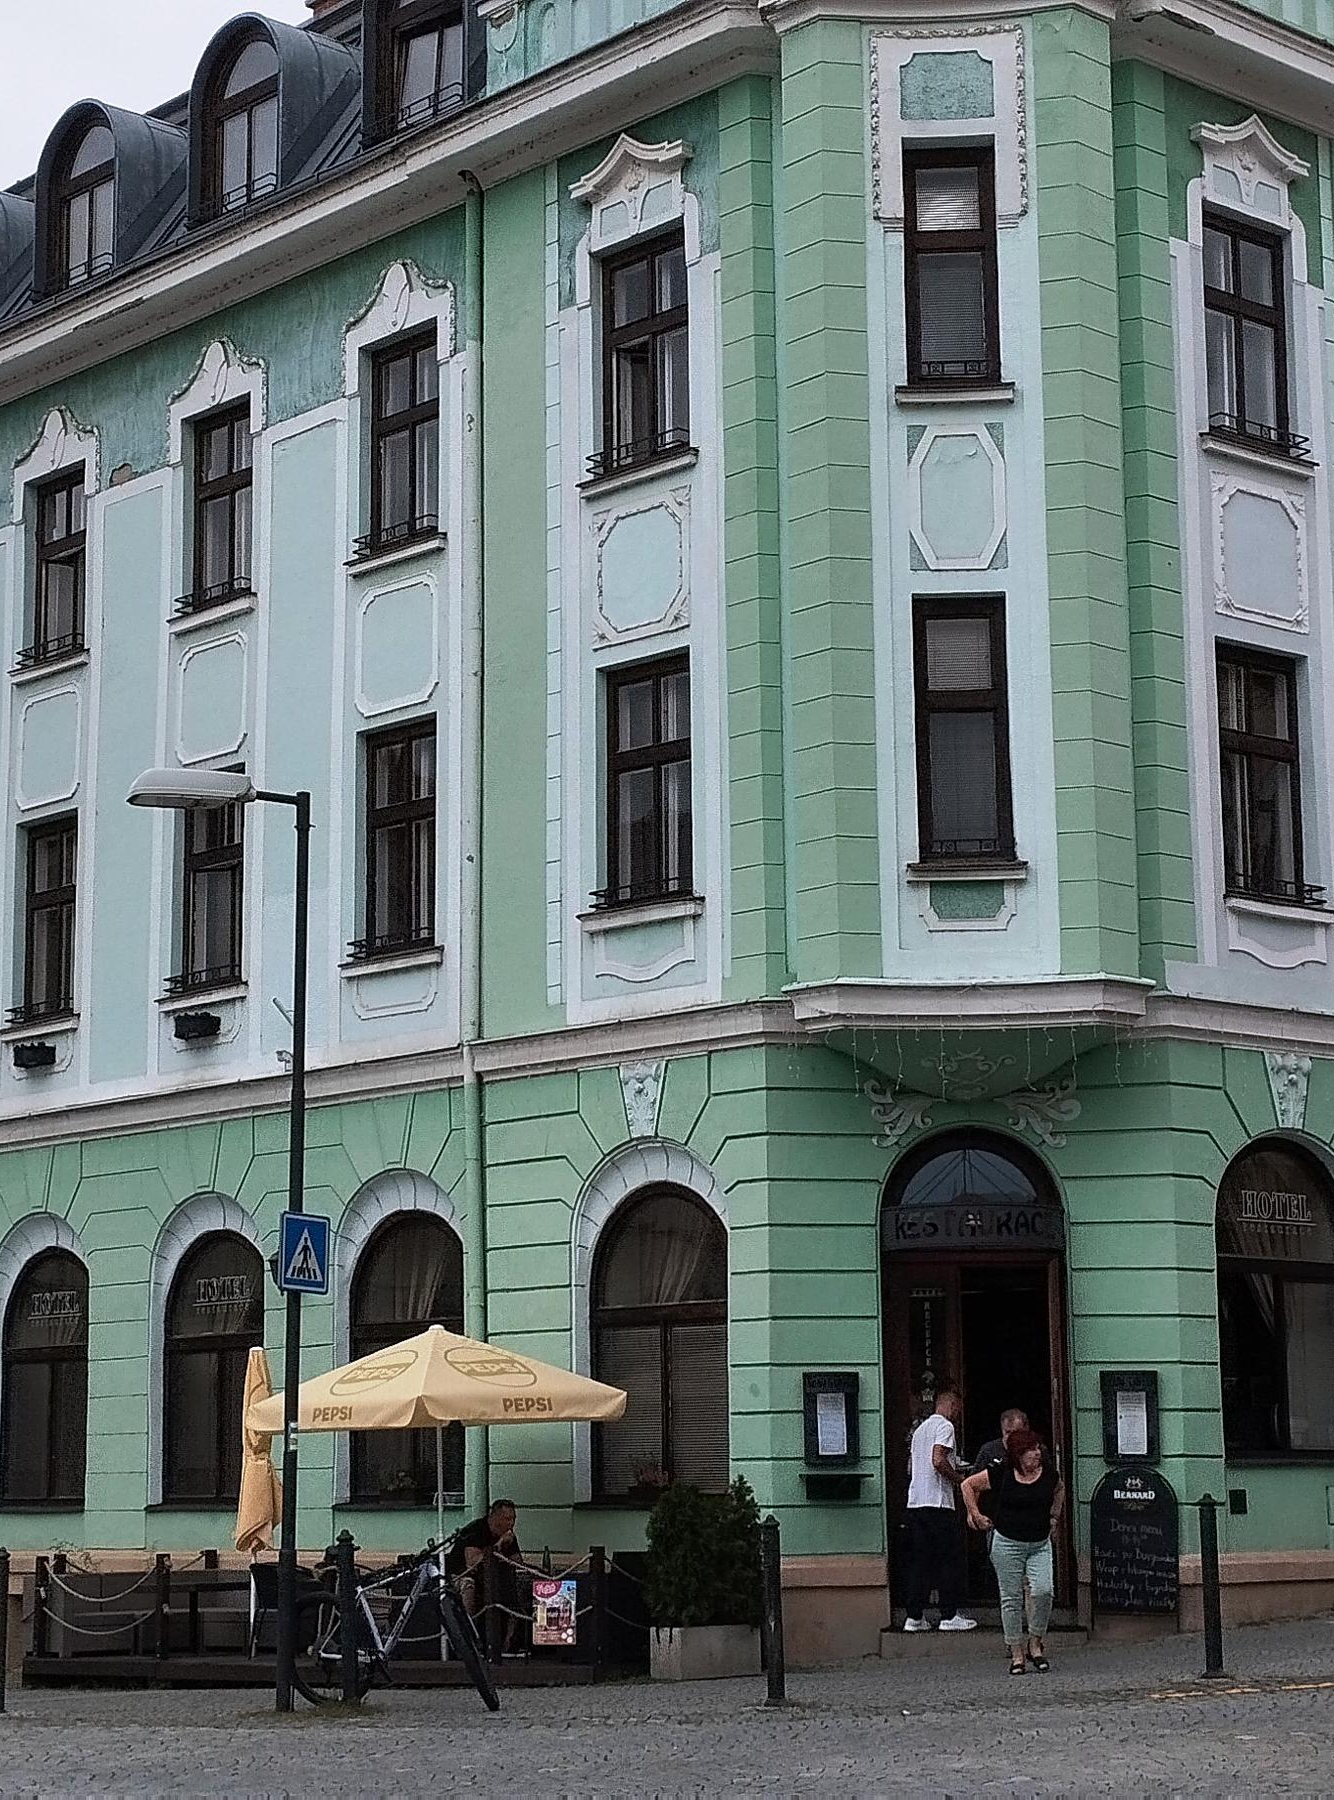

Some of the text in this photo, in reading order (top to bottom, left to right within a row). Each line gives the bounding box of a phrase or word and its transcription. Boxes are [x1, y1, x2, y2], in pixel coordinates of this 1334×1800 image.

[1241, 1190, 1312, 1221] HOTEL
[195, 1275, 251, 1302] HOTEL
[31, 1291, 79, 1315] HOTEL
[456, 1360, 529, 1375] PEPSI
[312, 1406, 353, 1422] PEPSI
[502, 1397, 553, 1412] PEPSI
